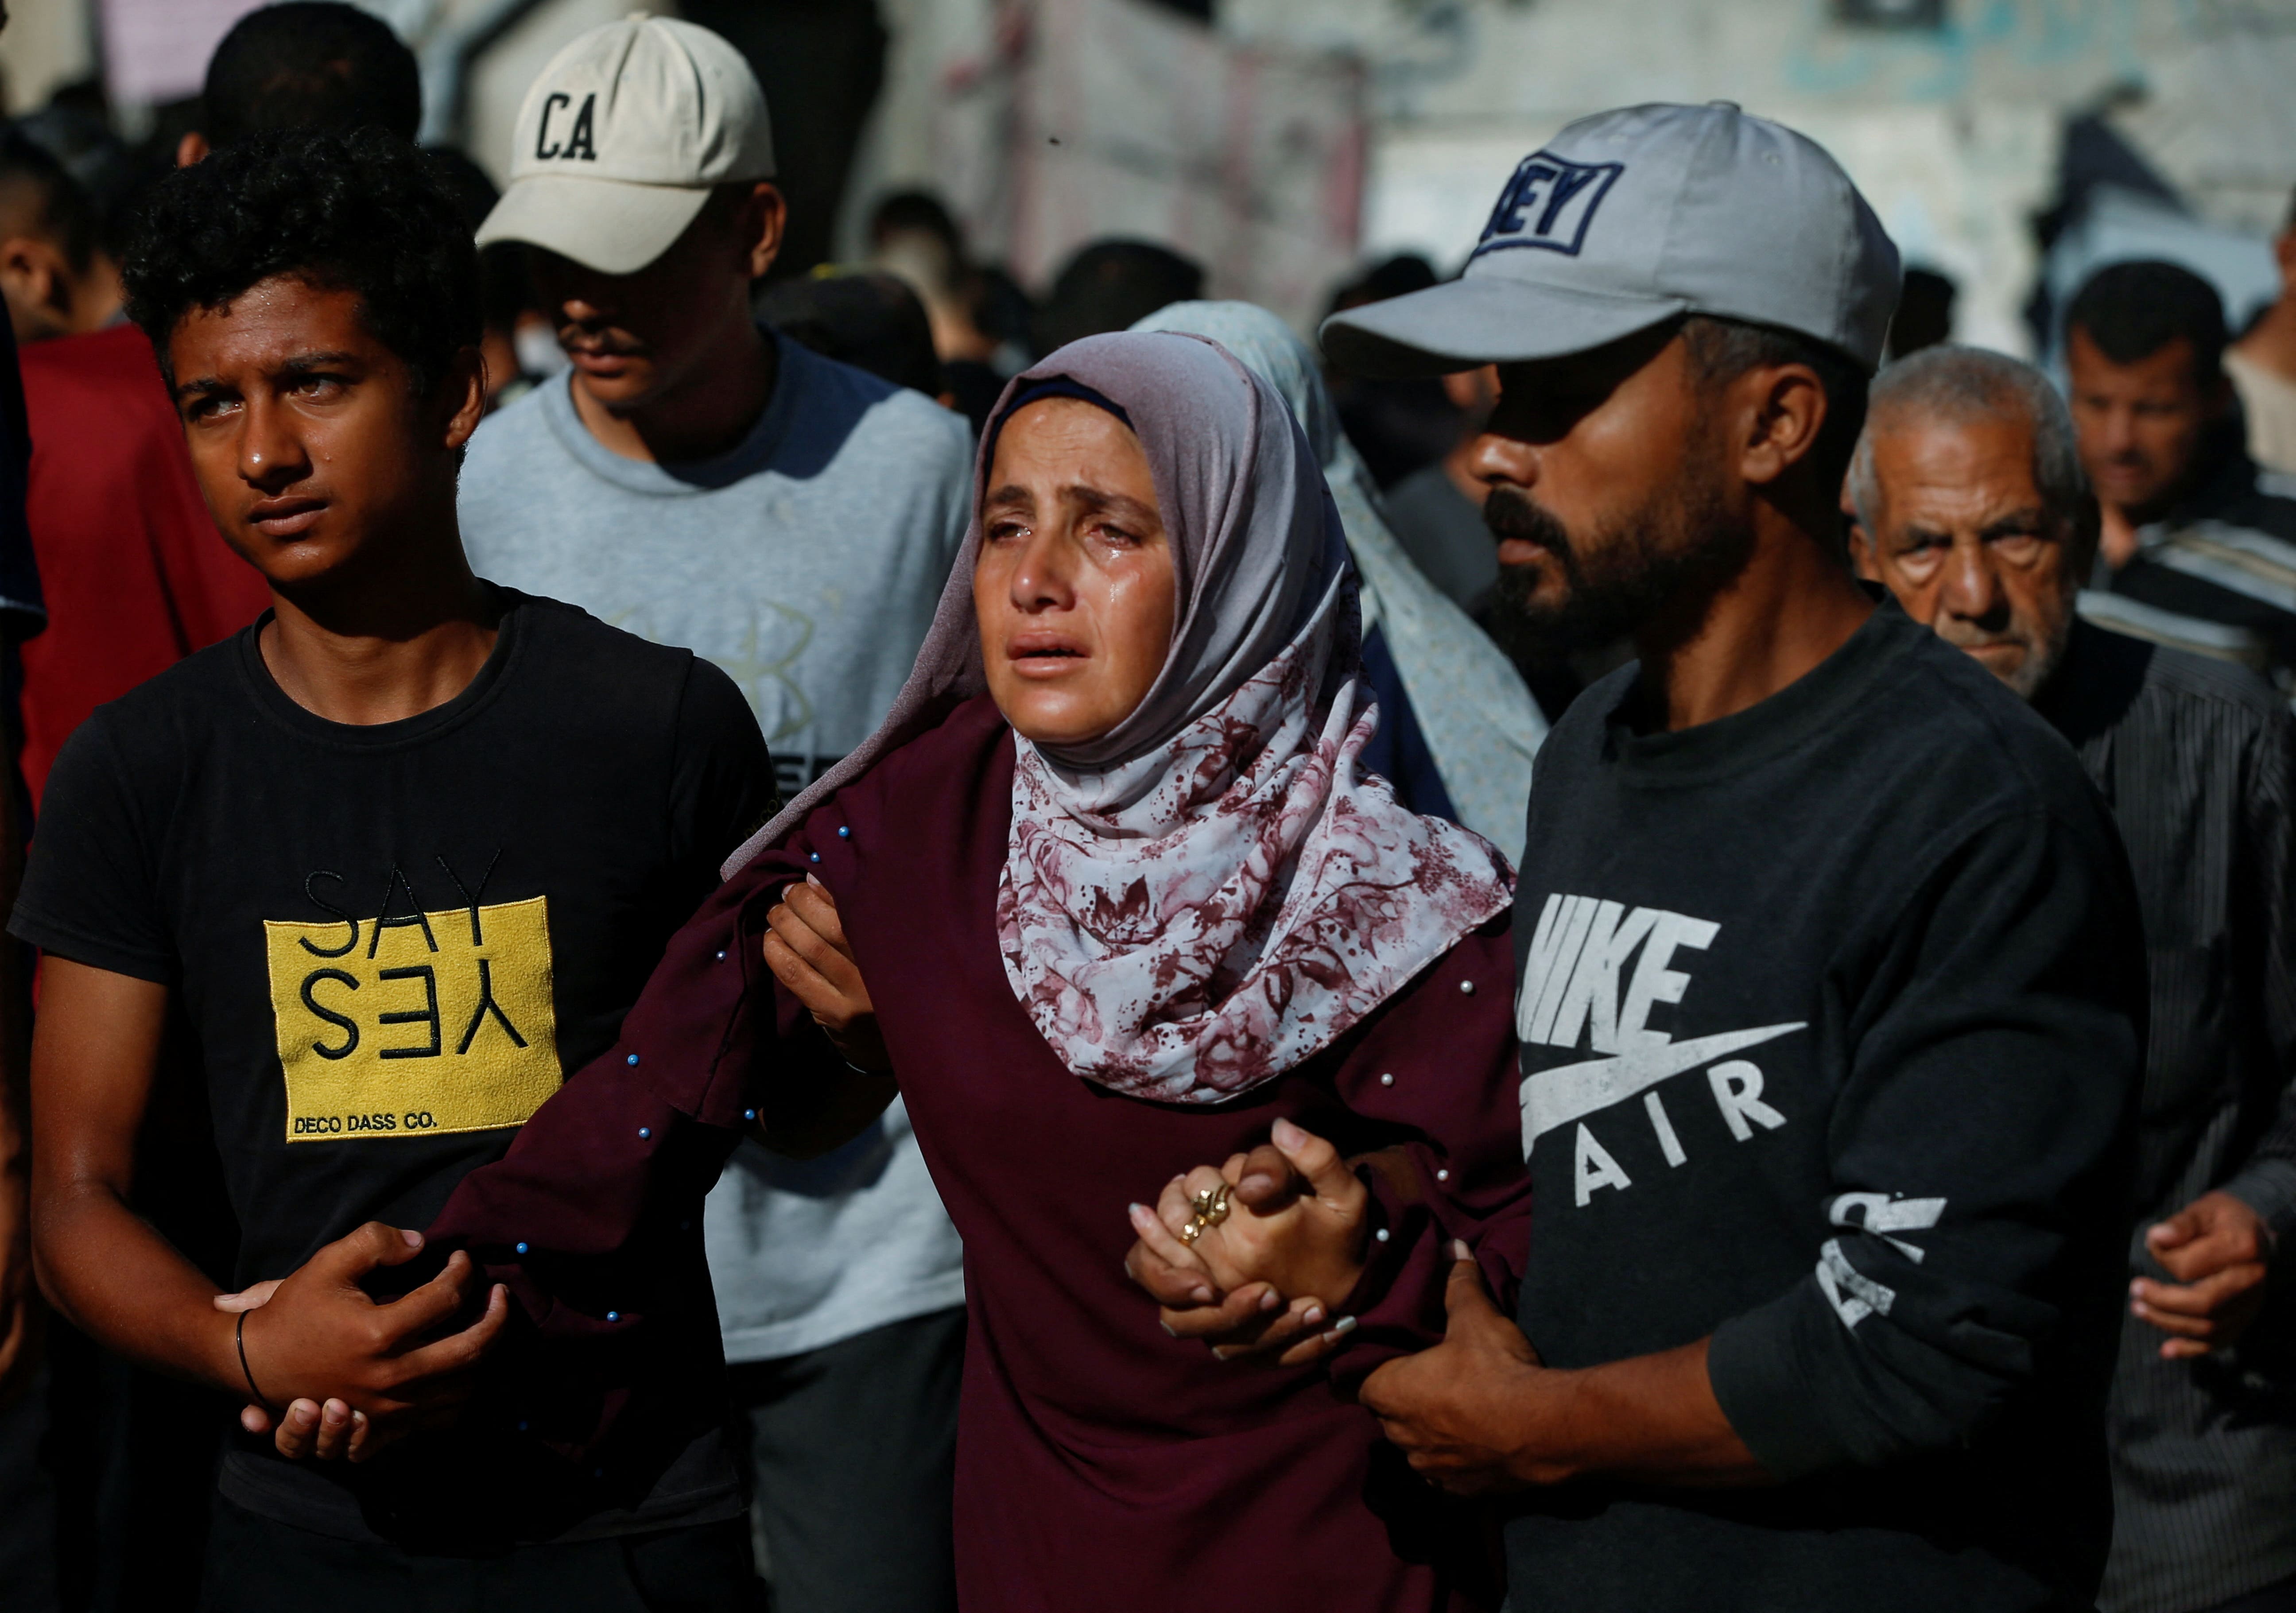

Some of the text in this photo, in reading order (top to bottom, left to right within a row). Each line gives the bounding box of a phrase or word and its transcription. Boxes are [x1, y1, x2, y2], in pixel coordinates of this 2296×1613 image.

[536, 93, 597, 161] CA
[299, 848, 503, 959] SAY
[300, 959, 528, 1060] YES
[295, 1111, 437, 1134] DECO DASS CO.
[1575, 1059, 1787, 1208] AIR
